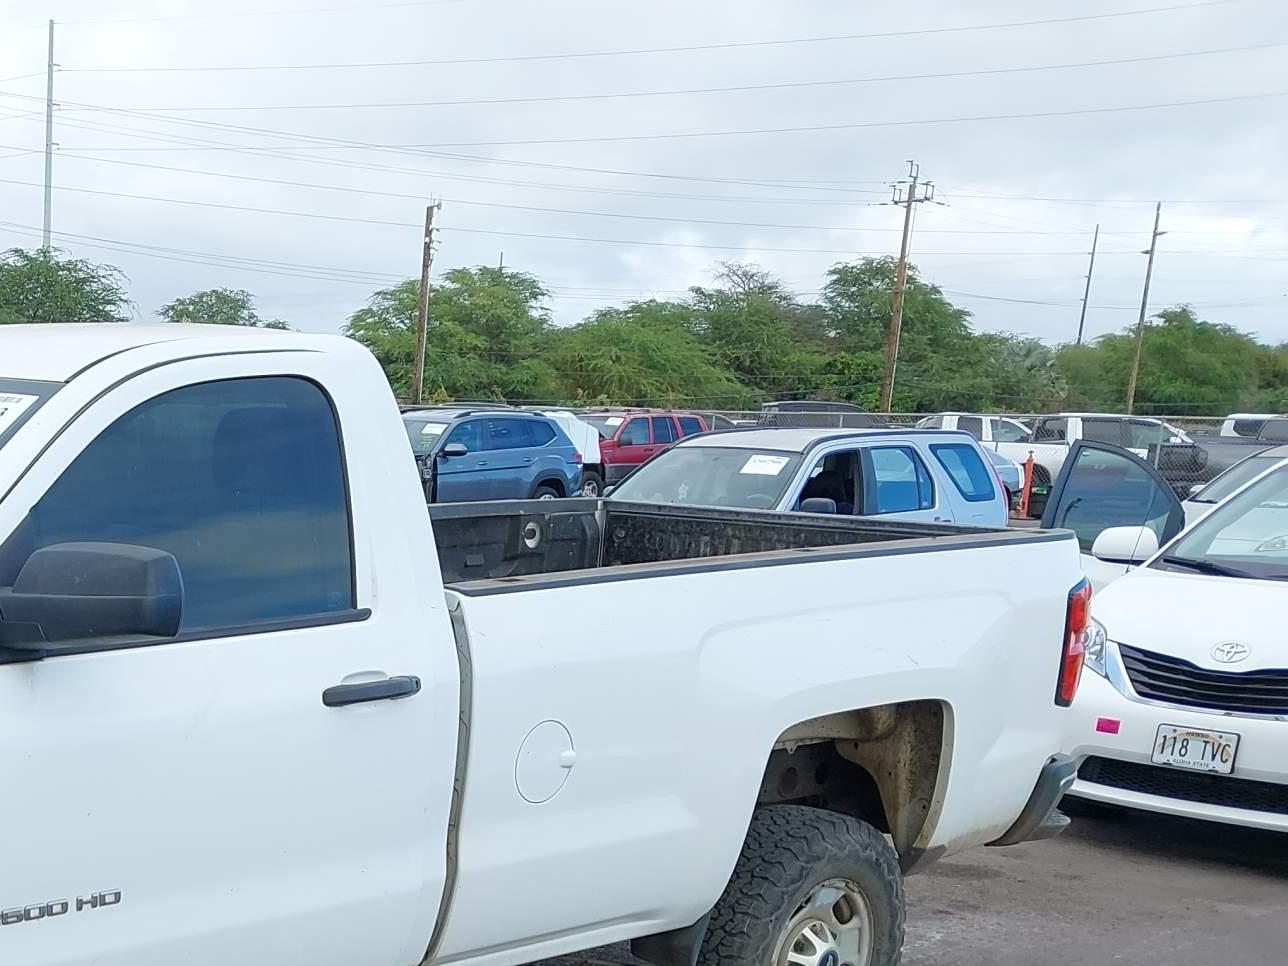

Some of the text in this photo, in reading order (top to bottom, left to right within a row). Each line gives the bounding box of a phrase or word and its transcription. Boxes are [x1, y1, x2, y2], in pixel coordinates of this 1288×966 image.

[1160, 735, 1232, 764] 118 TVC
[76, 888, 122, 912] HD
